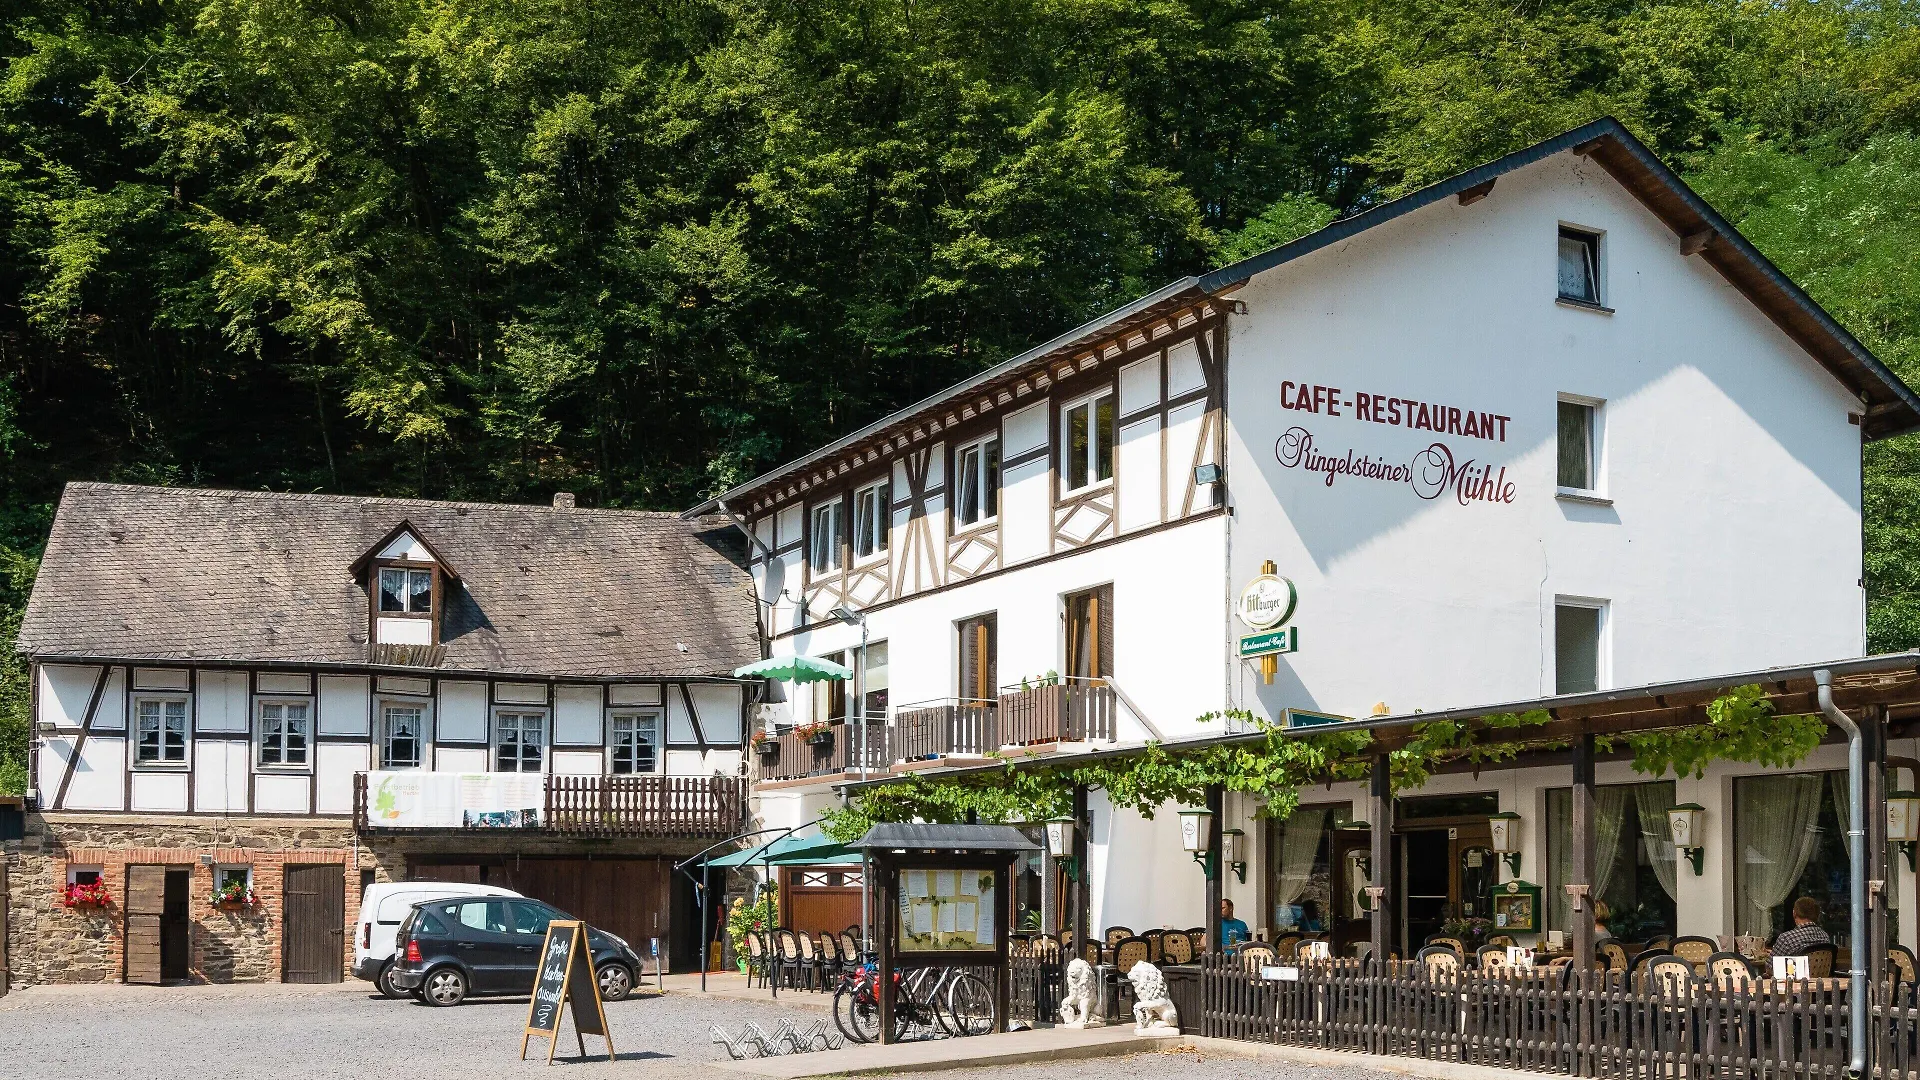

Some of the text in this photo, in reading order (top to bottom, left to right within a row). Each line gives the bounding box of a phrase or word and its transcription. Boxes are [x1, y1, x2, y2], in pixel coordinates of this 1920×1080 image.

[1280, 380, 1511, 443] CAFE-RESTAURANT
[1275, 426, 1516, 506] Ringelsteiner Mühle
[1246, 593, 1281, 613] Bitburger
